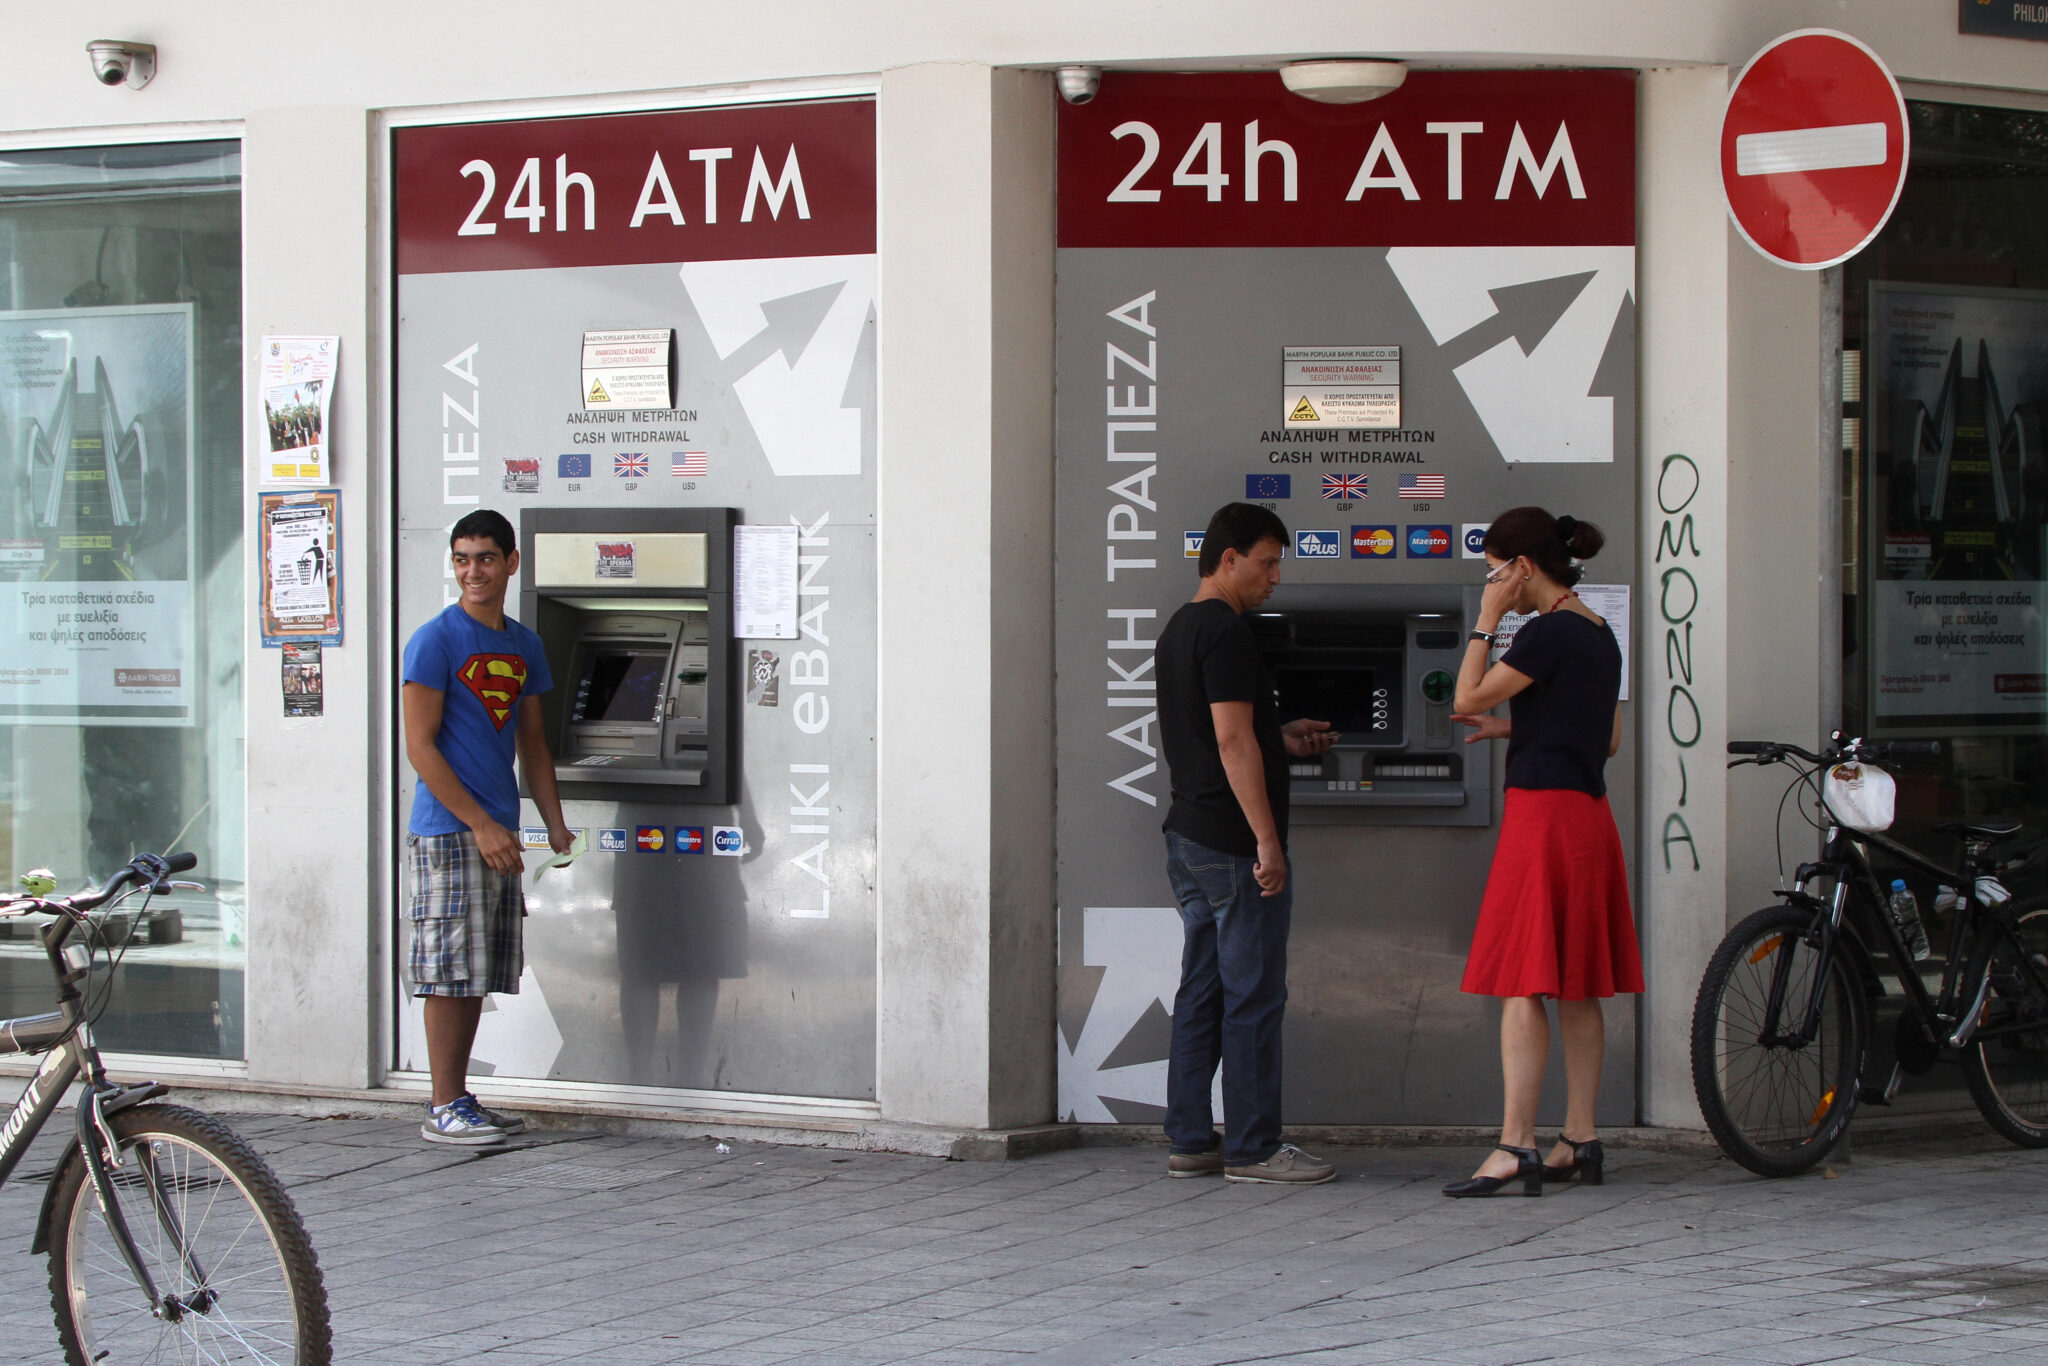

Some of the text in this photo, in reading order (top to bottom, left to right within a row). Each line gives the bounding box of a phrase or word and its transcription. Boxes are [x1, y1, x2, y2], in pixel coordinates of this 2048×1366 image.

[2014, 3, 2048, 23] PHILO
[1107, 118, 1587, 202] 24h ATM
[457, 142, 811, 236] 24h ATM
[1310, 374, 1374, 382] SECURITY WARNING
[567, 410, 698, 424] ΑΝΑΛΗΨΗ ΜΕΤΡΗΤΩΝ
[573, 431, 690, 444] CASH WITHDRAWAL
[1106, 289, 1157, 582] ΤΡΑΠΕΖΑ
[1260, 430, 1435, 443] ΑΝΑΛΗΨΗ ΜΕΤΡΗΤΩΝ
[1269, 452, 1425, 463] CASH WITHDRAWAL
[568, 484, 581, 492] EUR
[625, 483, 638, 491] GBP
[682, 482, 696, 490] USD
[1336, 503, 1353, 511] GBP
[1413, 503, 1430, 511] USD
[1353, 537, 1394, 546] MasterCard
[1411, 537, 1447, 545] Maestro
[1468, 535, 1484, 545] Cir
[1309, 543, 1337, 555] PLUS
[21, 590, 155, 607] Τρία καταθετικά σχέδια
[1906, 590, 2031, 608] Τρία καταθετικά σχέδια
[57, 609, 119, 626] με ευελιξία
[790, 511, 830, 735] eBANK
[1942, 610, 1998, 628] με ευελιξία
[29, 628, 147, 644] και ψηλές αποδόσεις
[1914, 631, 2025, 647] και ψηλές αποδόσεις
[529, 834, 546, 842] VISA
[607, 839, 624, 849] PLUS
[637, 836, 664, 844] MasterCard
[678, 836, 701, 844] Maestro
[716, 835, 740, 845] Cirrus
[790, 764, 830, 919] LAIKI
[0, 1076, 42, 1160] MONT
